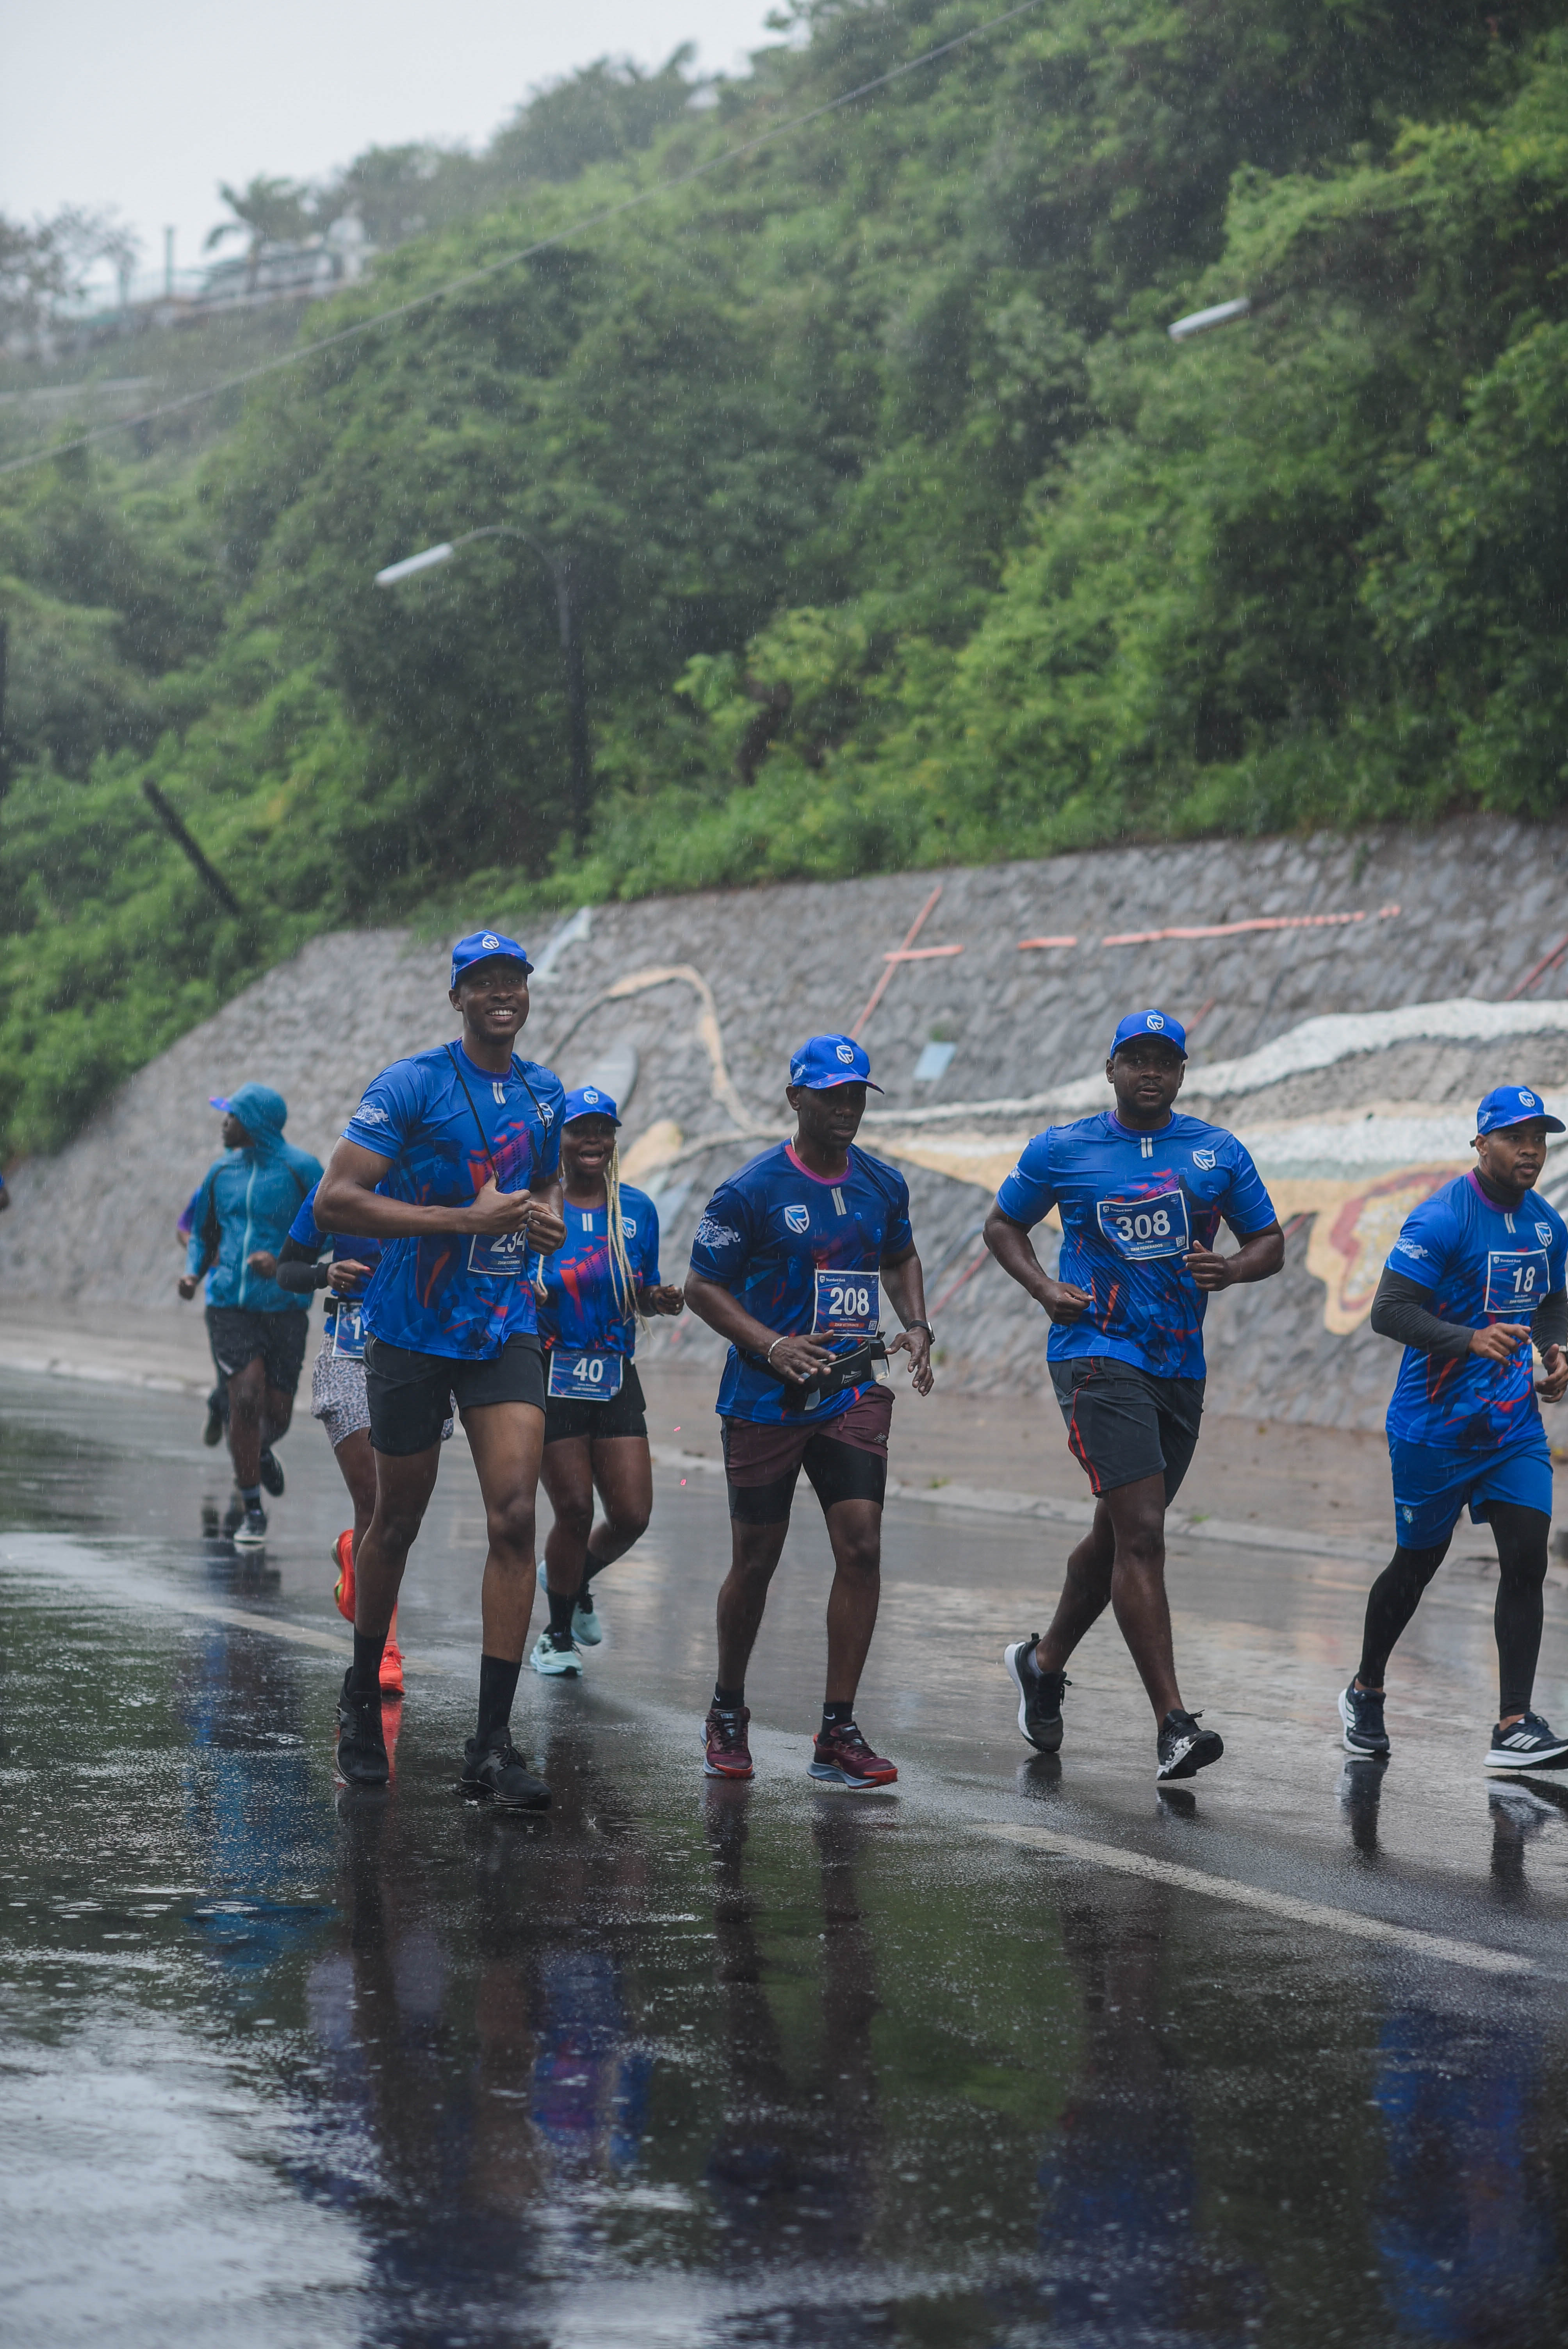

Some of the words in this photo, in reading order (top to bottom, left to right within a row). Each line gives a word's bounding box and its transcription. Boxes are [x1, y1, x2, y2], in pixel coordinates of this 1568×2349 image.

[1116, 1210, 1171, 1241] 308
[1513, 1266, 1535, 1293] 18
[829, 1287, 870, 1316] 208
[573, 1358, 603, 1383] 40
